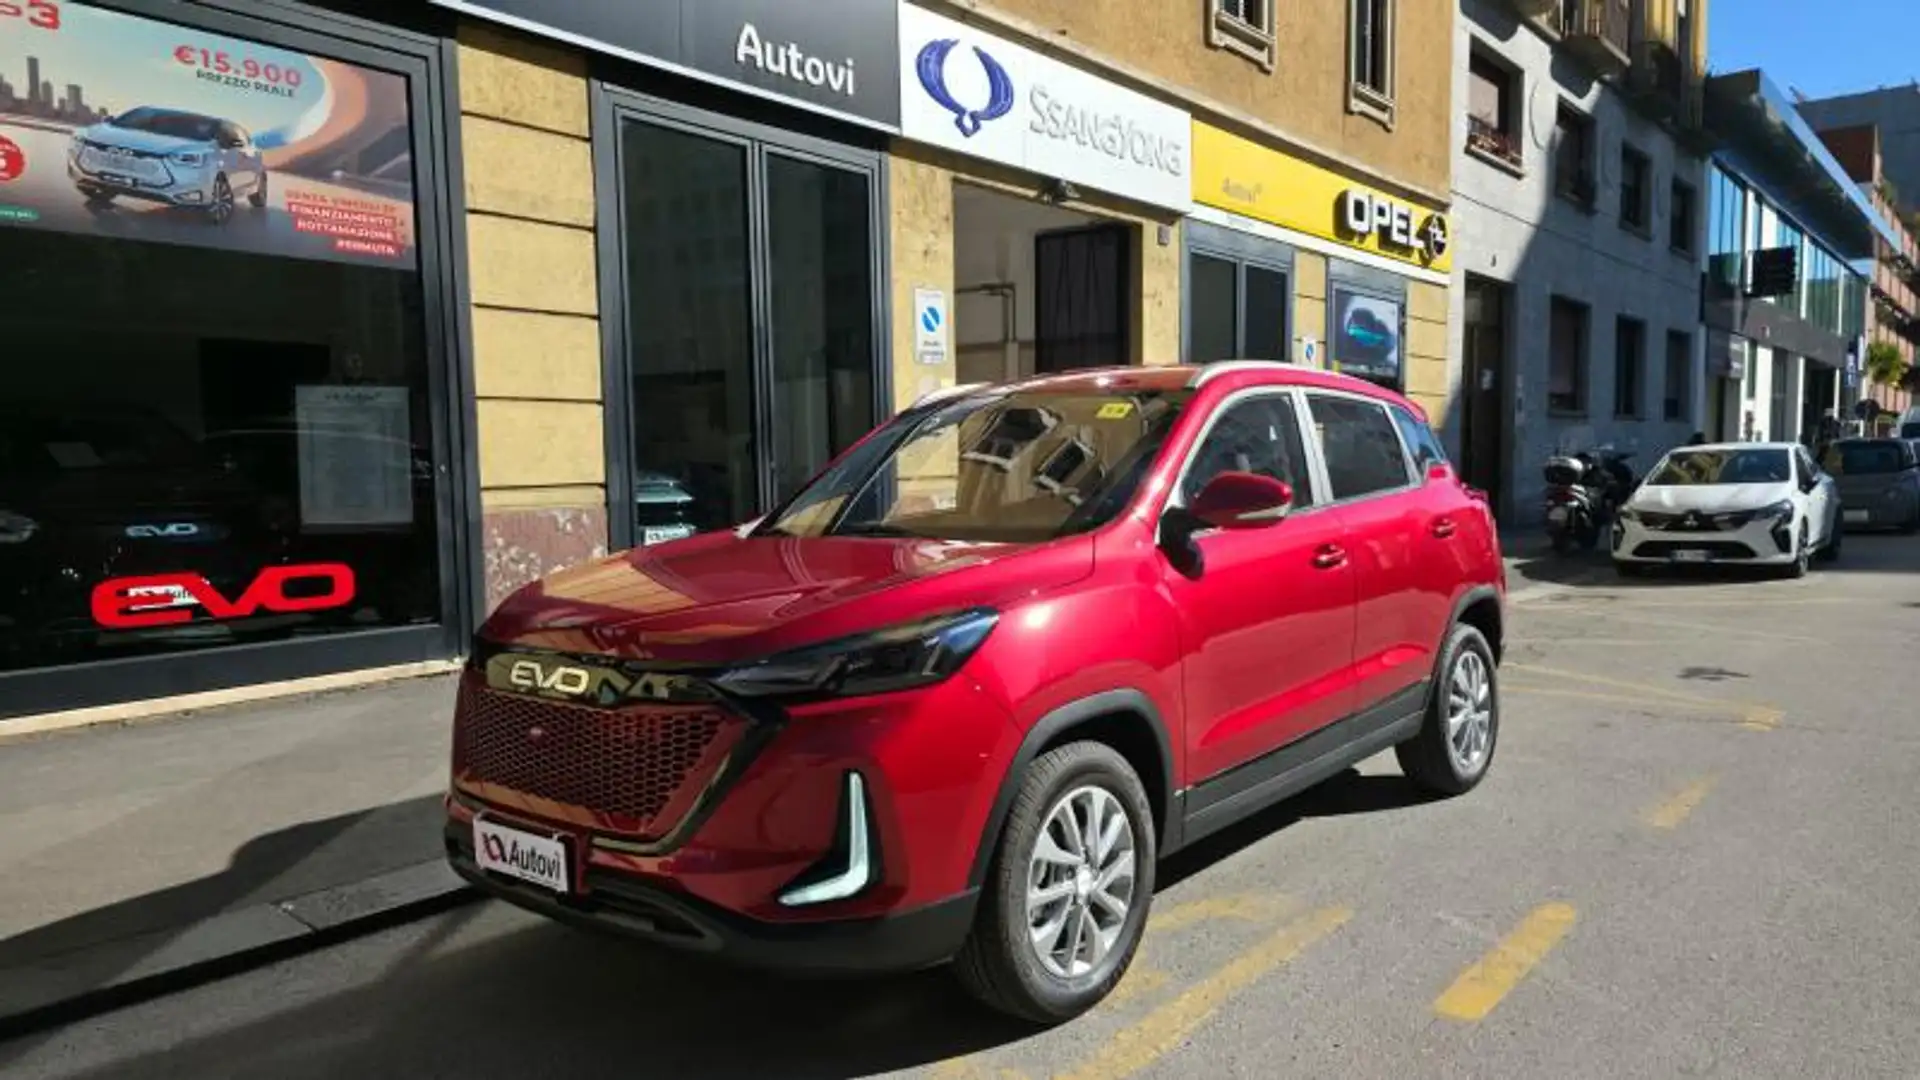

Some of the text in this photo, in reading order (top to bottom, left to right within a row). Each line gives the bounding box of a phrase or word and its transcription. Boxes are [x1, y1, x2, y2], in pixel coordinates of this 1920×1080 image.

[174, 45, 300, 87] €15.900
[196, 68, 250, 89] PREZZO
[736, 22, 853, 95] Autovi
[1030, 85, 1182, 177] SSANGYONG
[1343, 187, 1425, 249] OPEL
[125, 523, 199, 538] EVO
[91, 562, 355, 628] EVO
[510, 660, 590, 694] EVO
[508, 839, 561, 880] Autovi
